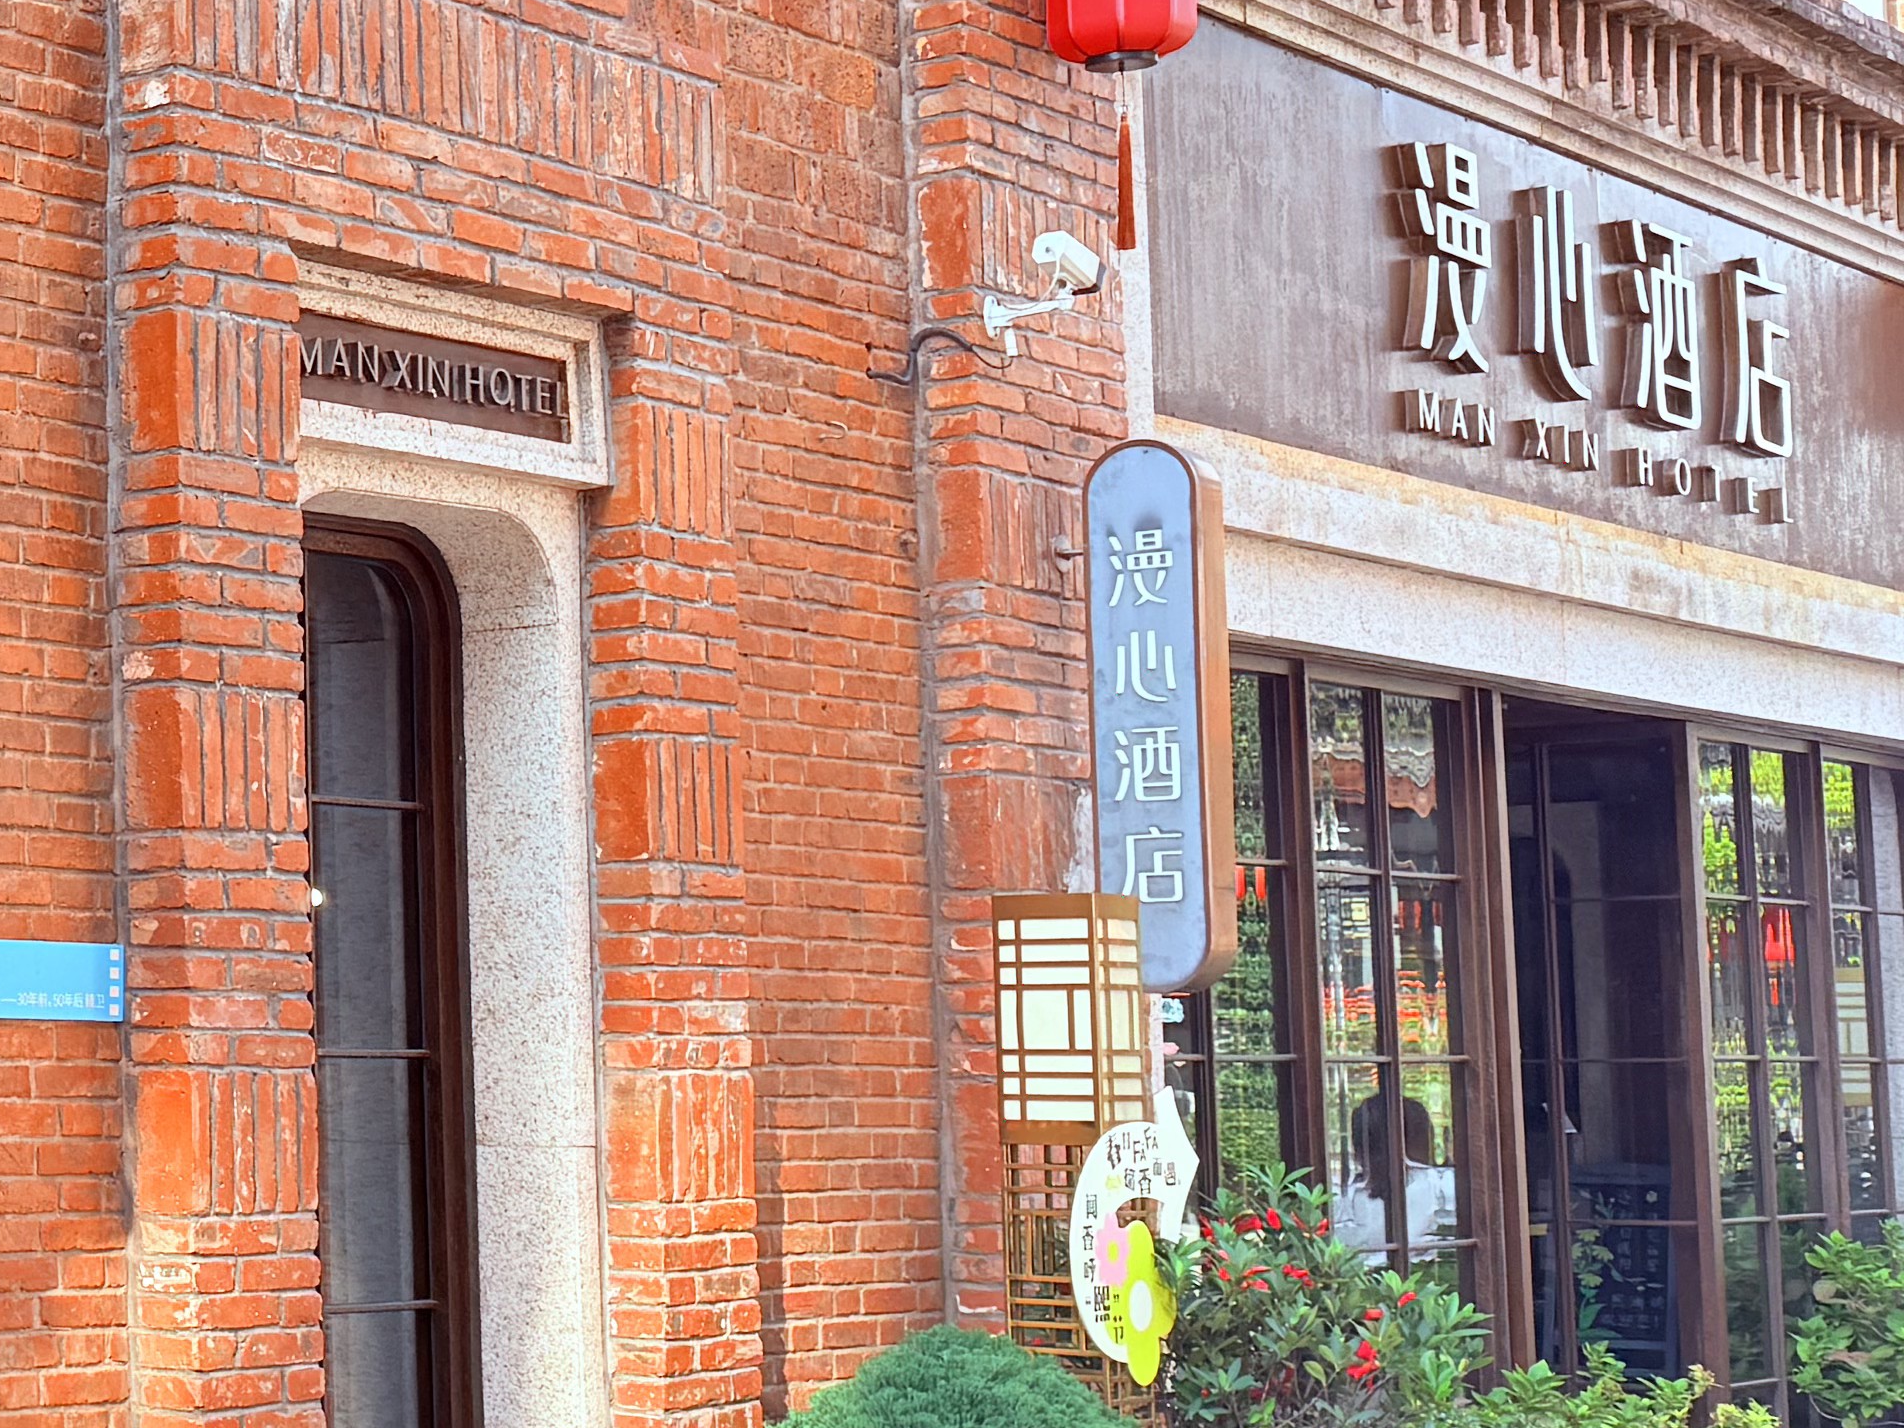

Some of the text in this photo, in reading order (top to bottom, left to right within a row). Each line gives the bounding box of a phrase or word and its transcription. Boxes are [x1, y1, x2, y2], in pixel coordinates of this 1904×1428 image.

[300, 337, 569, 417] MAN XIN HOTEL
[1415, 141, 1792, 458] 漫心酒店
[1418, 388, 1793, 523] MAN XIN HOTEL
[1108, 528, 1184, 904] 漫心酒店
